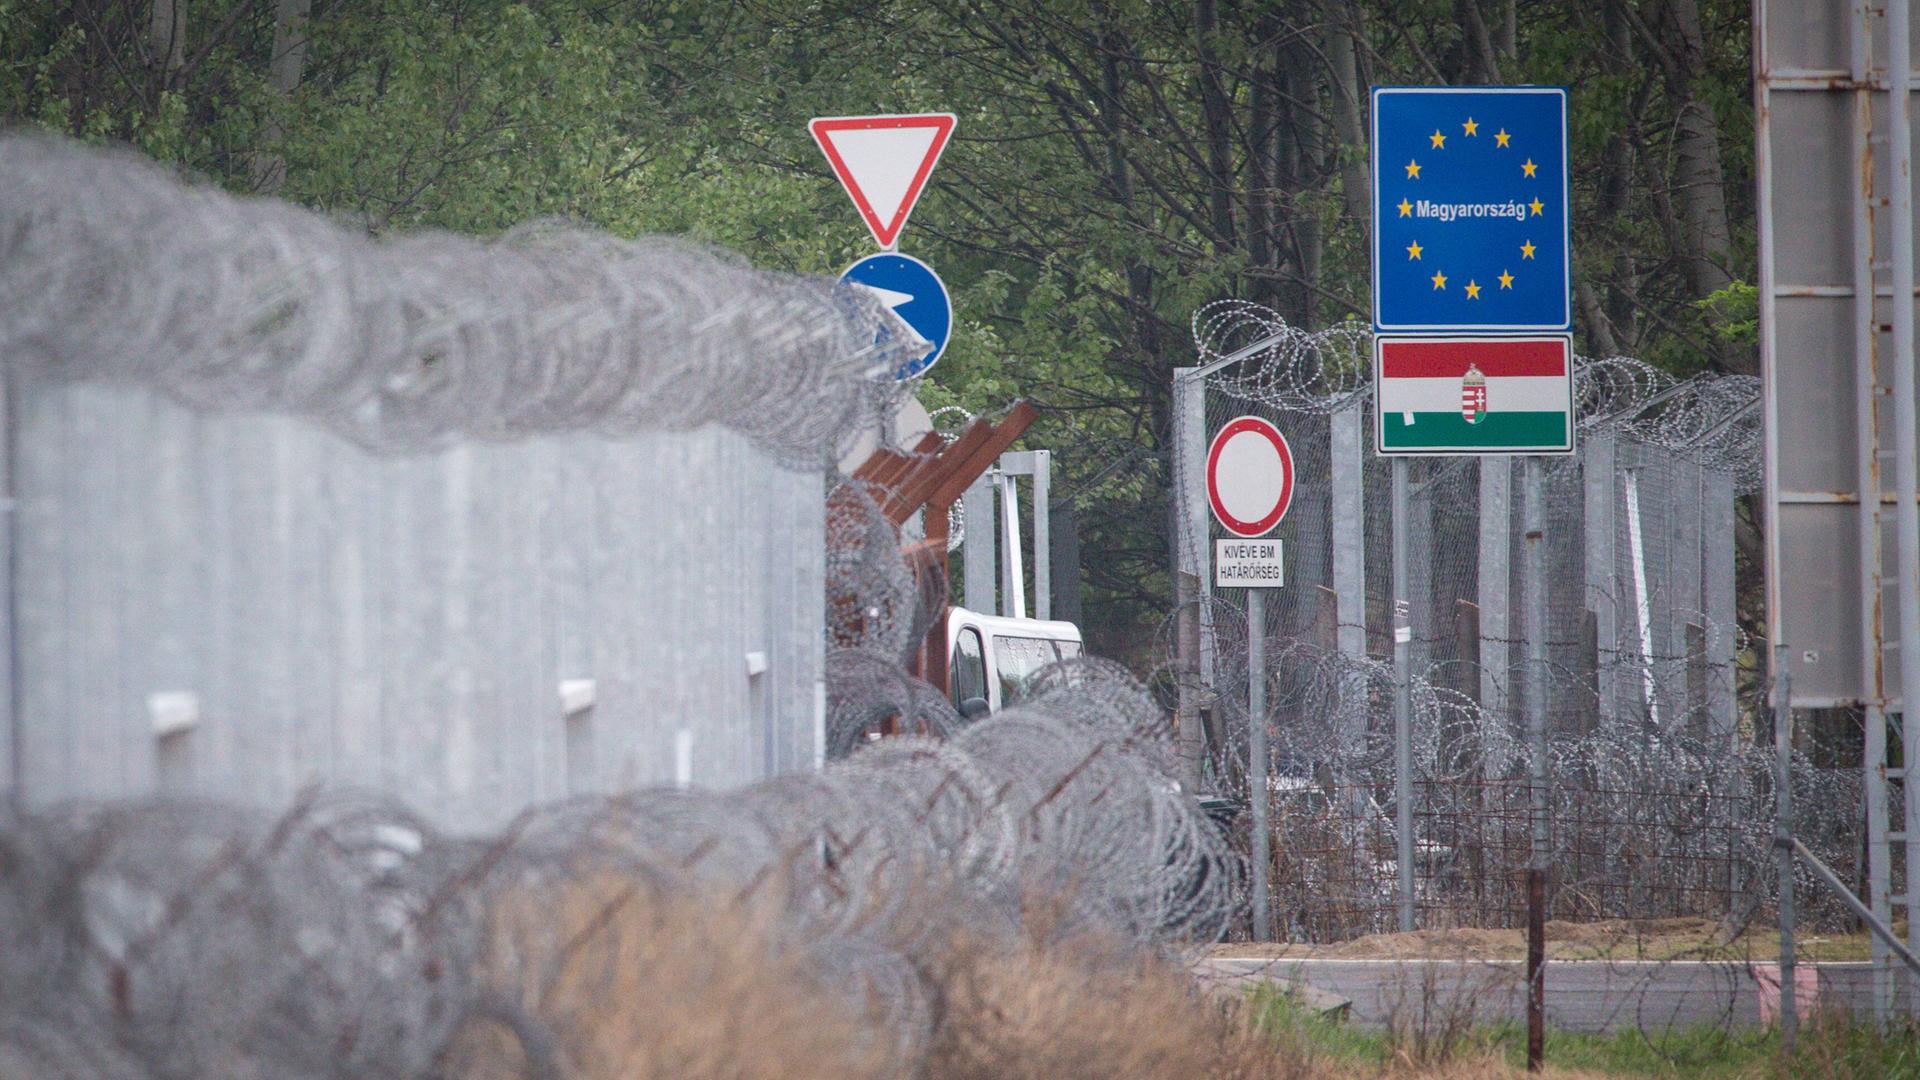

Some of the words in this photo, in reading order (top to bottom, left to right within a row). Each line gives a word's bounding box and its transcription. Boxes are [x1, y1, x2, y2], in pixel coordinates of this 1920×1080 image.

[1416, 199, 1525, 221] Magyarország
[1224, 542, 1258, 559] KIVÉVE
[1260, 545, 1275, 559] BM
[1220, 562, 1280, 579] HATÁRŐRSÉG
